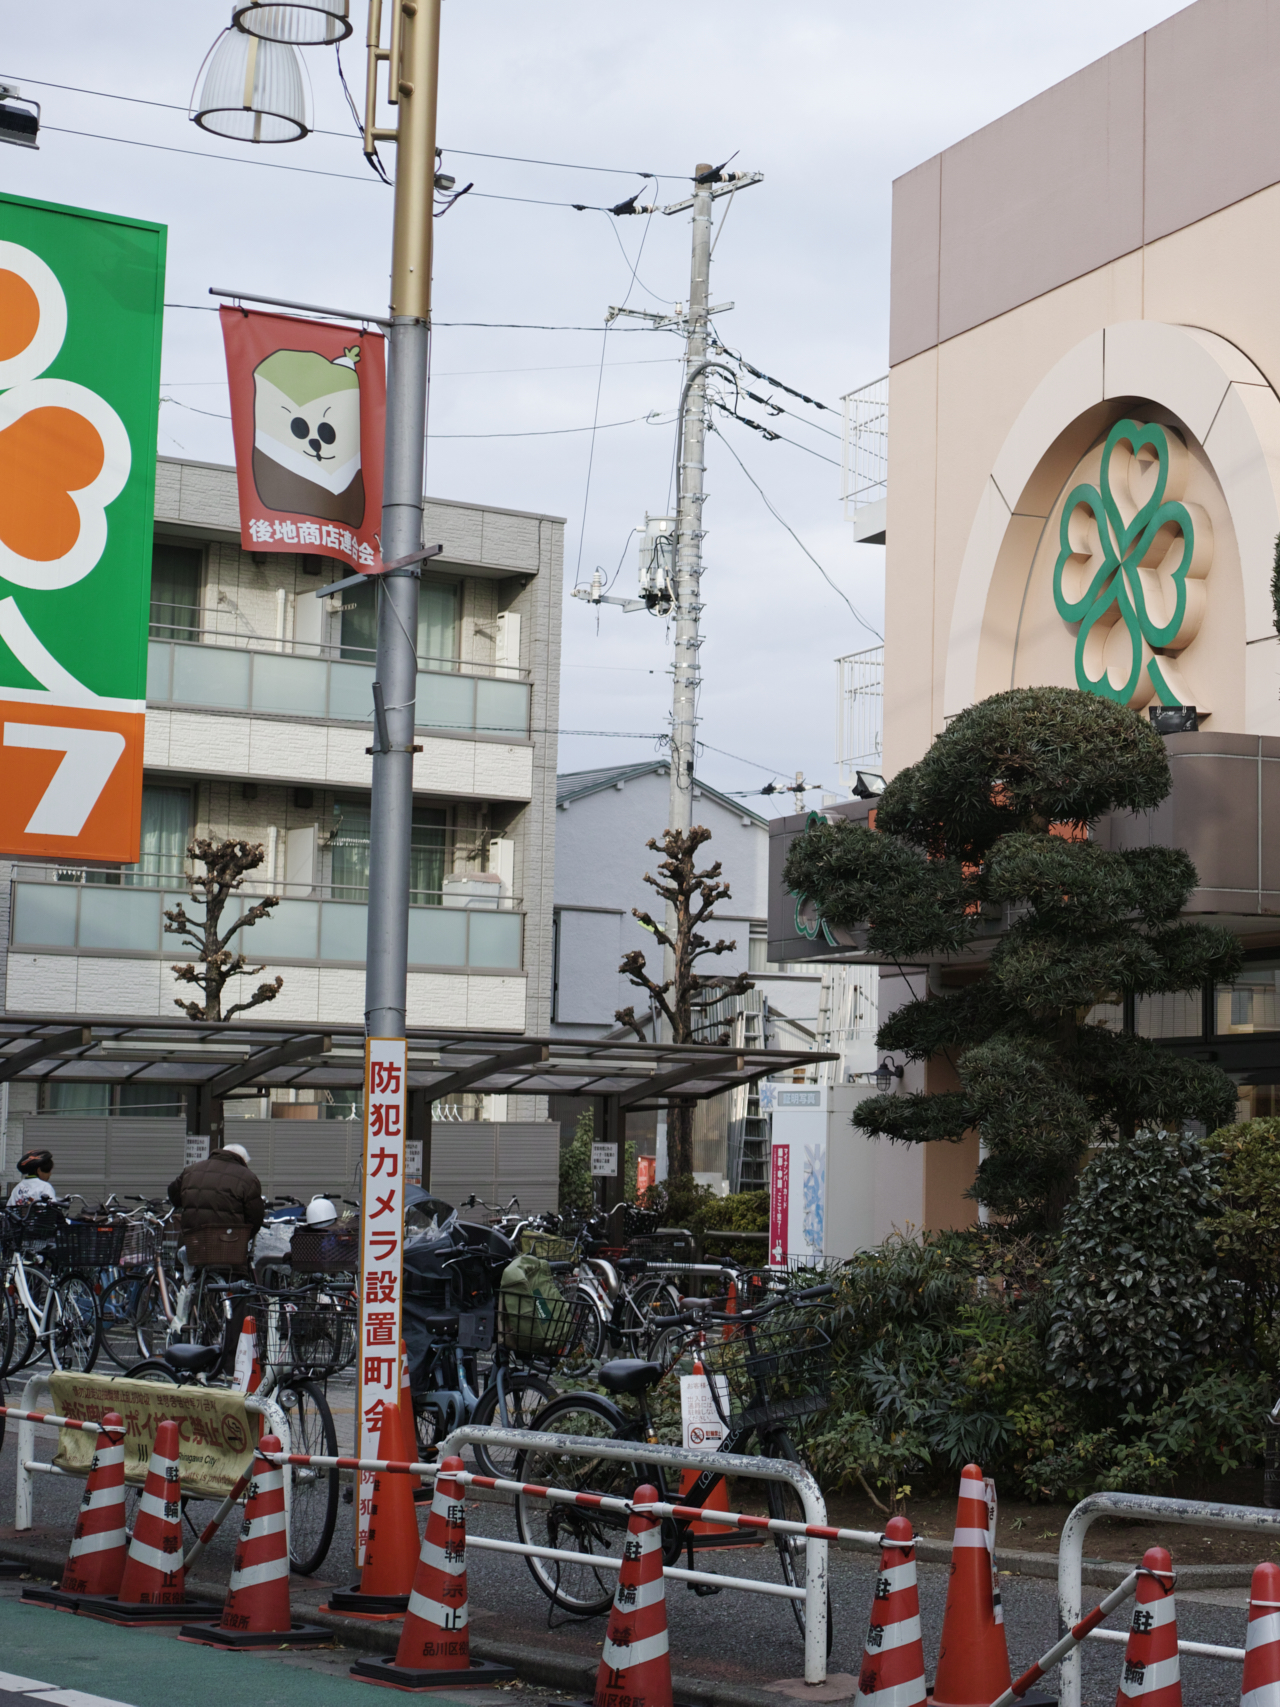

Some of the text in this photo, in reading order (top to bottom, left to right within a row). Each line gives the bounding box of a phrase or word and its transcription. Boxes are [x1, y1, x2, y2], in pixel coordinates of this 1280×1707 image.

[248, 518, 375, 566] 後地商店連合会
[783, 1093, 816, 1104] 証明写真
[162, 1466, 180, 1588] 駐輪禁止
[606, 1540, 643, 1690] 駐輪禁止
[1124, 1609, 1155, 1686] 駐輪
